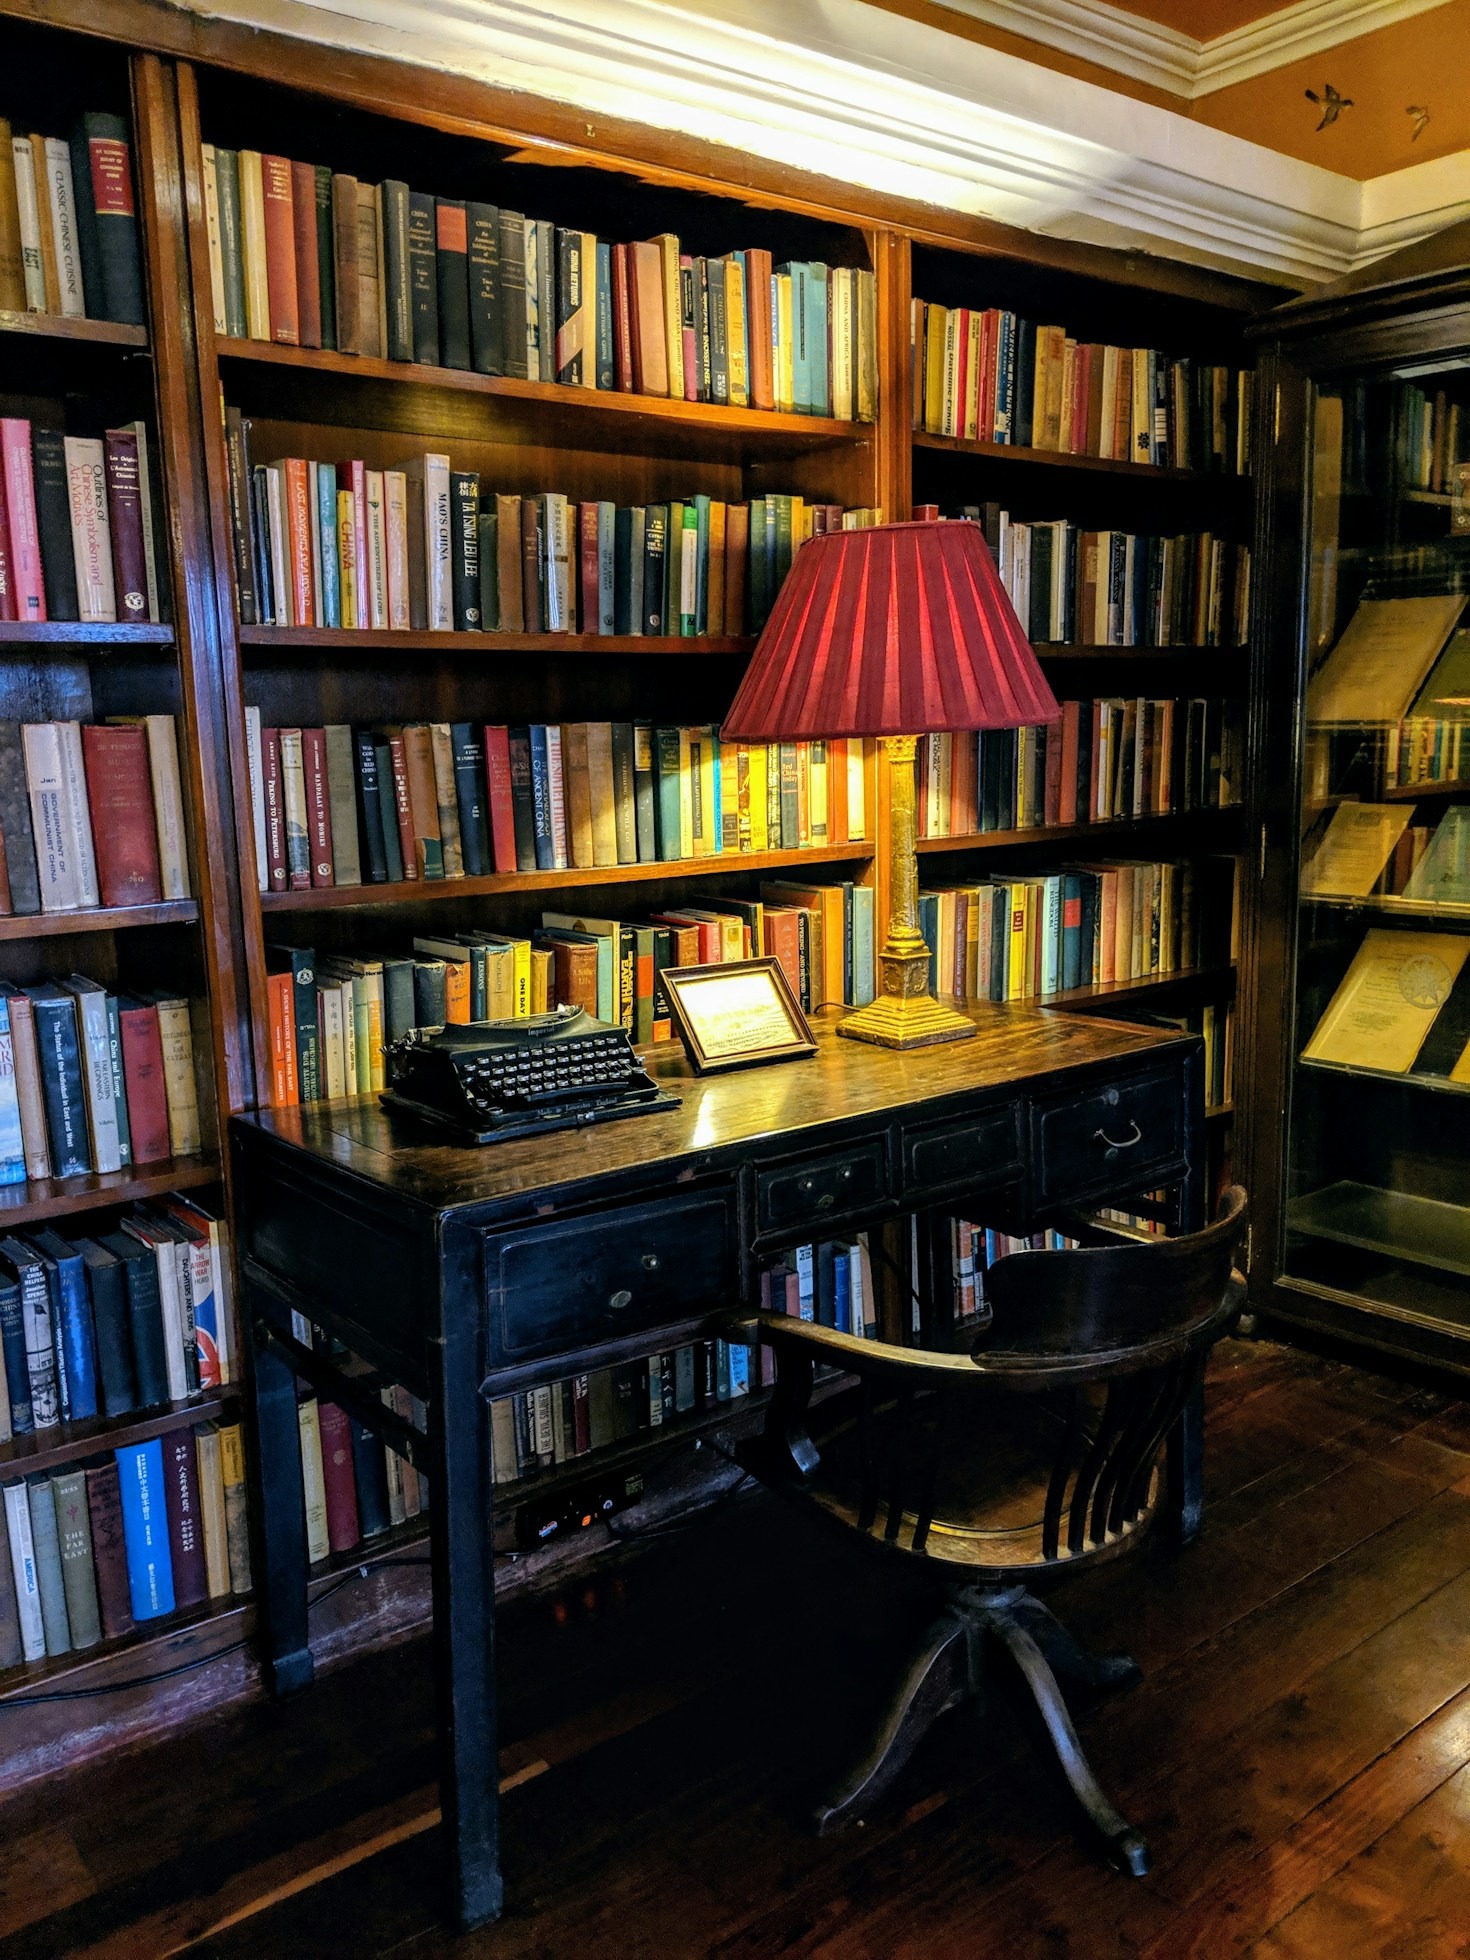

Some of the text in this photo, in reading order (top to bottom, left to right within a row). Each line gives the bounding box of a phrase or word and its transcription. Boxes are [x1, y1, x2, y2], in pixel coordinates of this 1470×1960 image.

[56, 171, 77, 295] CLASSIC CHINESE CUISINE
[570, 250, 578, 306] CHINA RETURNS
[69, 463, 83, 527] Art Motives
[80, 464, 93, 505] Chinese
[92, 465, 107, 522] Outlines of
[84, 507, 100, 563] Symbolism
[438, 492, 448, 560] MAO'S CHINA
[462, 501, 477, 577] TA TSING LEU LEE
[341, 521, 356, 570] CHINA
[533, 760, 541, 771] OF
[268, 780, 276, 805] PEKING
[315, 773, 323, 808] MANDALAY
[534, 775, 543, 808] ANCIENT
[41, 793, 57, 883] COMMUNIST CHINA
[51, 793, 64, 857] GOVERNMENT
[271, 818, 279, 859] PETERSBURG
[536, 812, 544, 837] CHINA
[621, 960, 629, 997] EARTH
[53, 1021, 61, 1033] The
[54, 1034, 63, 1053] Status
[110, 1040, 118, 1058] China
[59, 1072, 68, 1099] Individual
[94, 1061, 103, 1100] BEGINNINGS
[112, 1076, 121, 1097] Europe
[66, 1132, 74, 1147] West
[24, 1276, 46, 1285] HELPERS
[182, 1258, 191, 1296] DAUGHTERS
[191, 1259, 210, 1270] ARROW
[195, 1268, 208, 1277] WAR
[27, 1290, 46, 1298] SPENCE
[538, 1393, 551, 1451] THE DEVIL SOLDIER
[64, 1530, 84, 1540] THE
[66, 1540, 84, 1550] FAR
[64, 1548, 88, 1560] EAST
[24, 1558, 35, 1593] AMERICA
